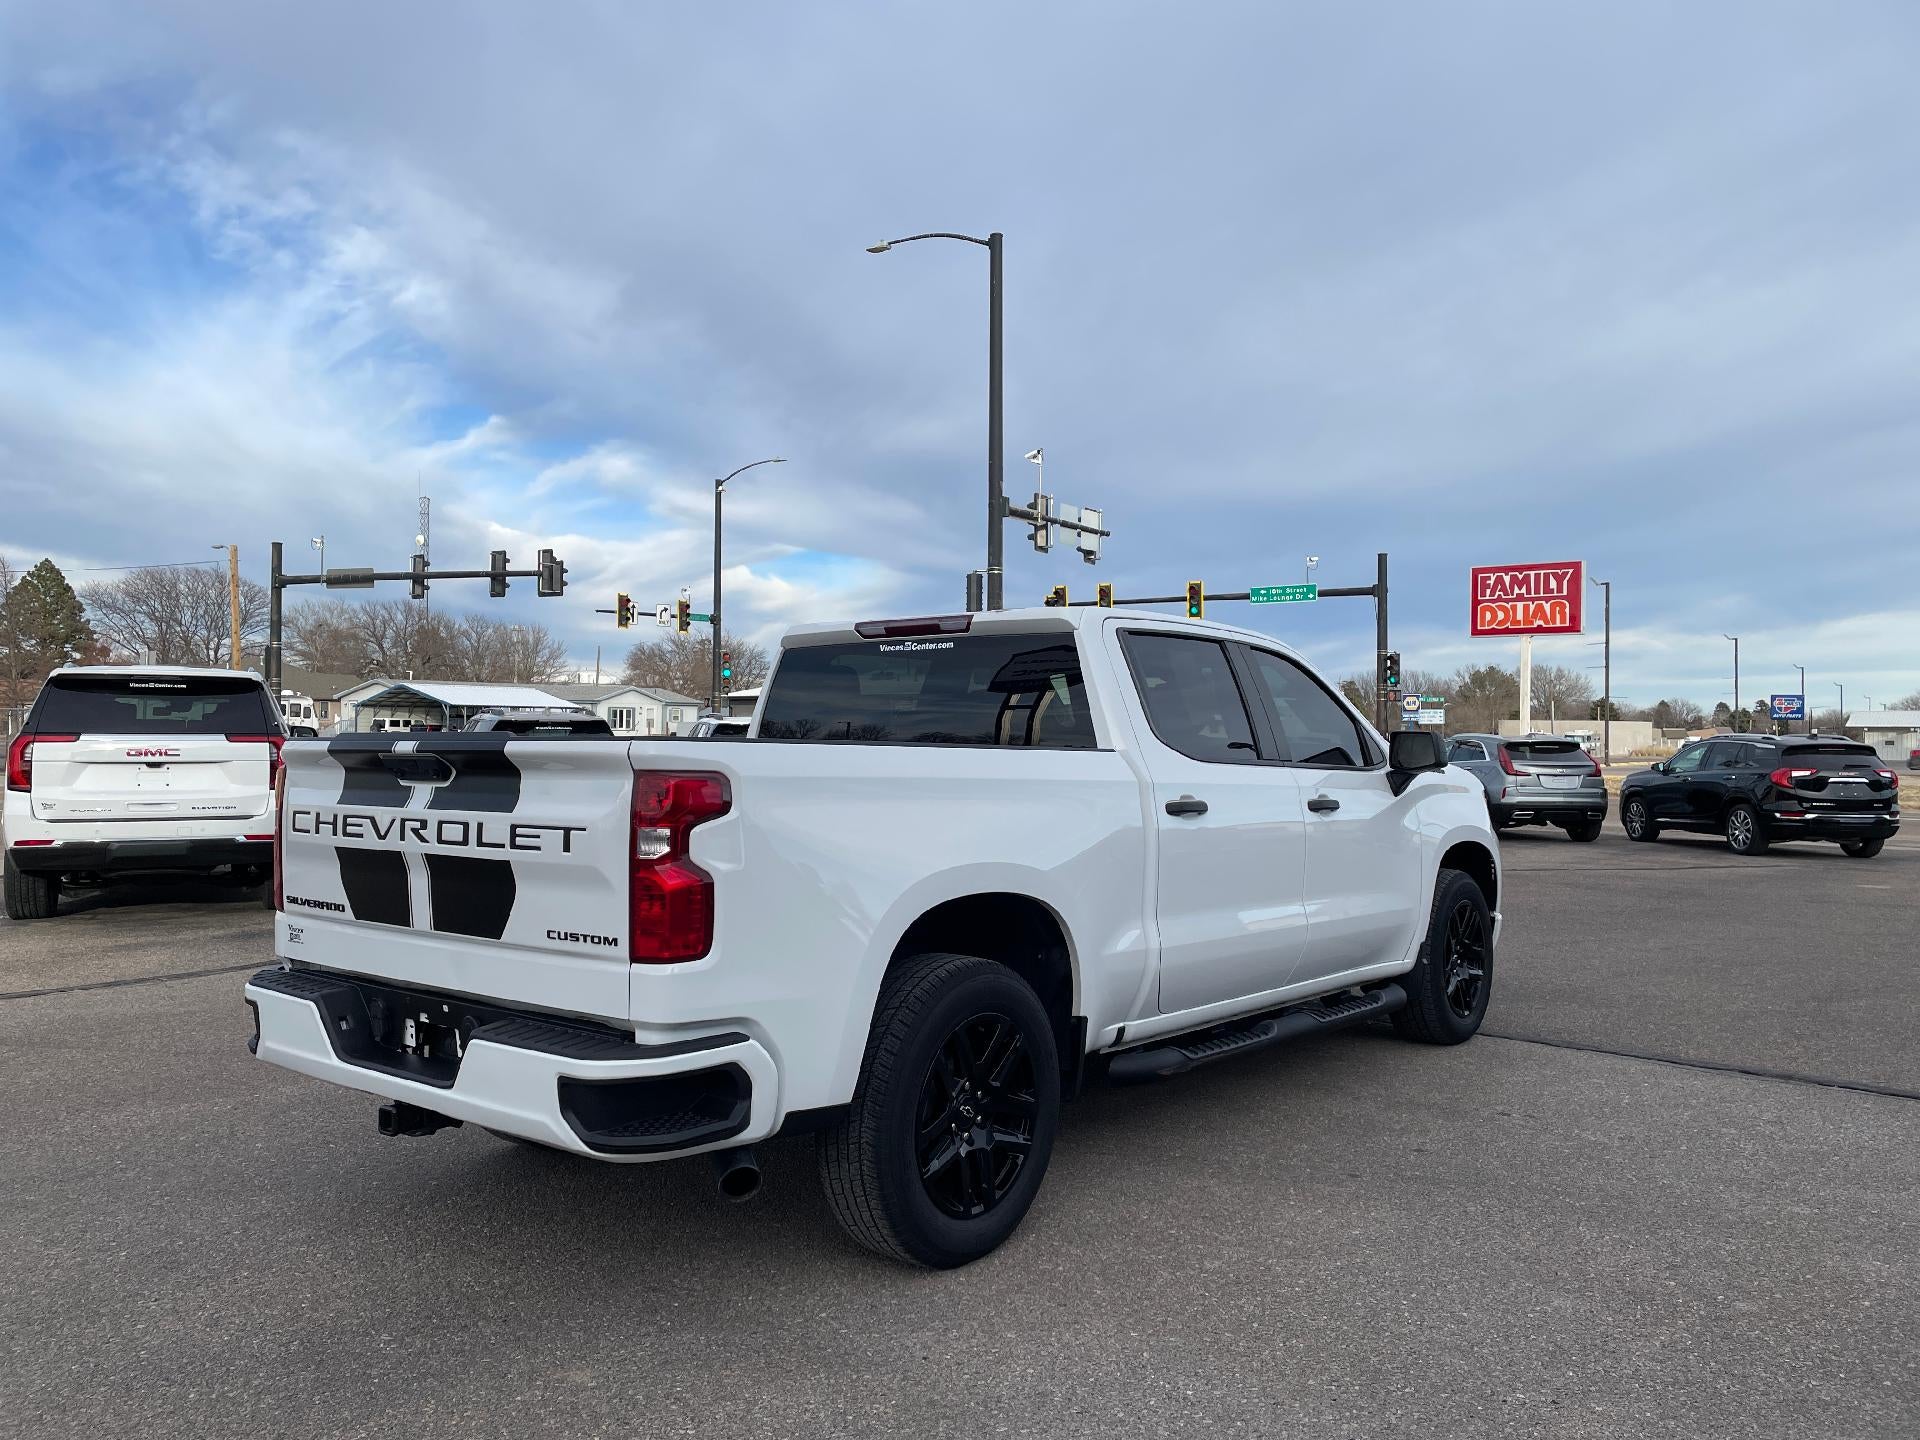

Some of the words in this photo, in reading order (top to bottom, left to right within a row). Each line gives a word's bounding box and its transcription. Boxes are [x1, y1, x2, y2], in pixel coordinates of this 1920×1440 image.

[1478, 569, 1574, 600] FAMILY
[1477, 599, 1570, 629] DOLLAR
[126, 748, 181, 758] GMC
[292, 810, 587, 854] CHEVROLET
[286, 895, 346, 913] SILVERADO
[546, 929, 619, 947] CUSTOM
